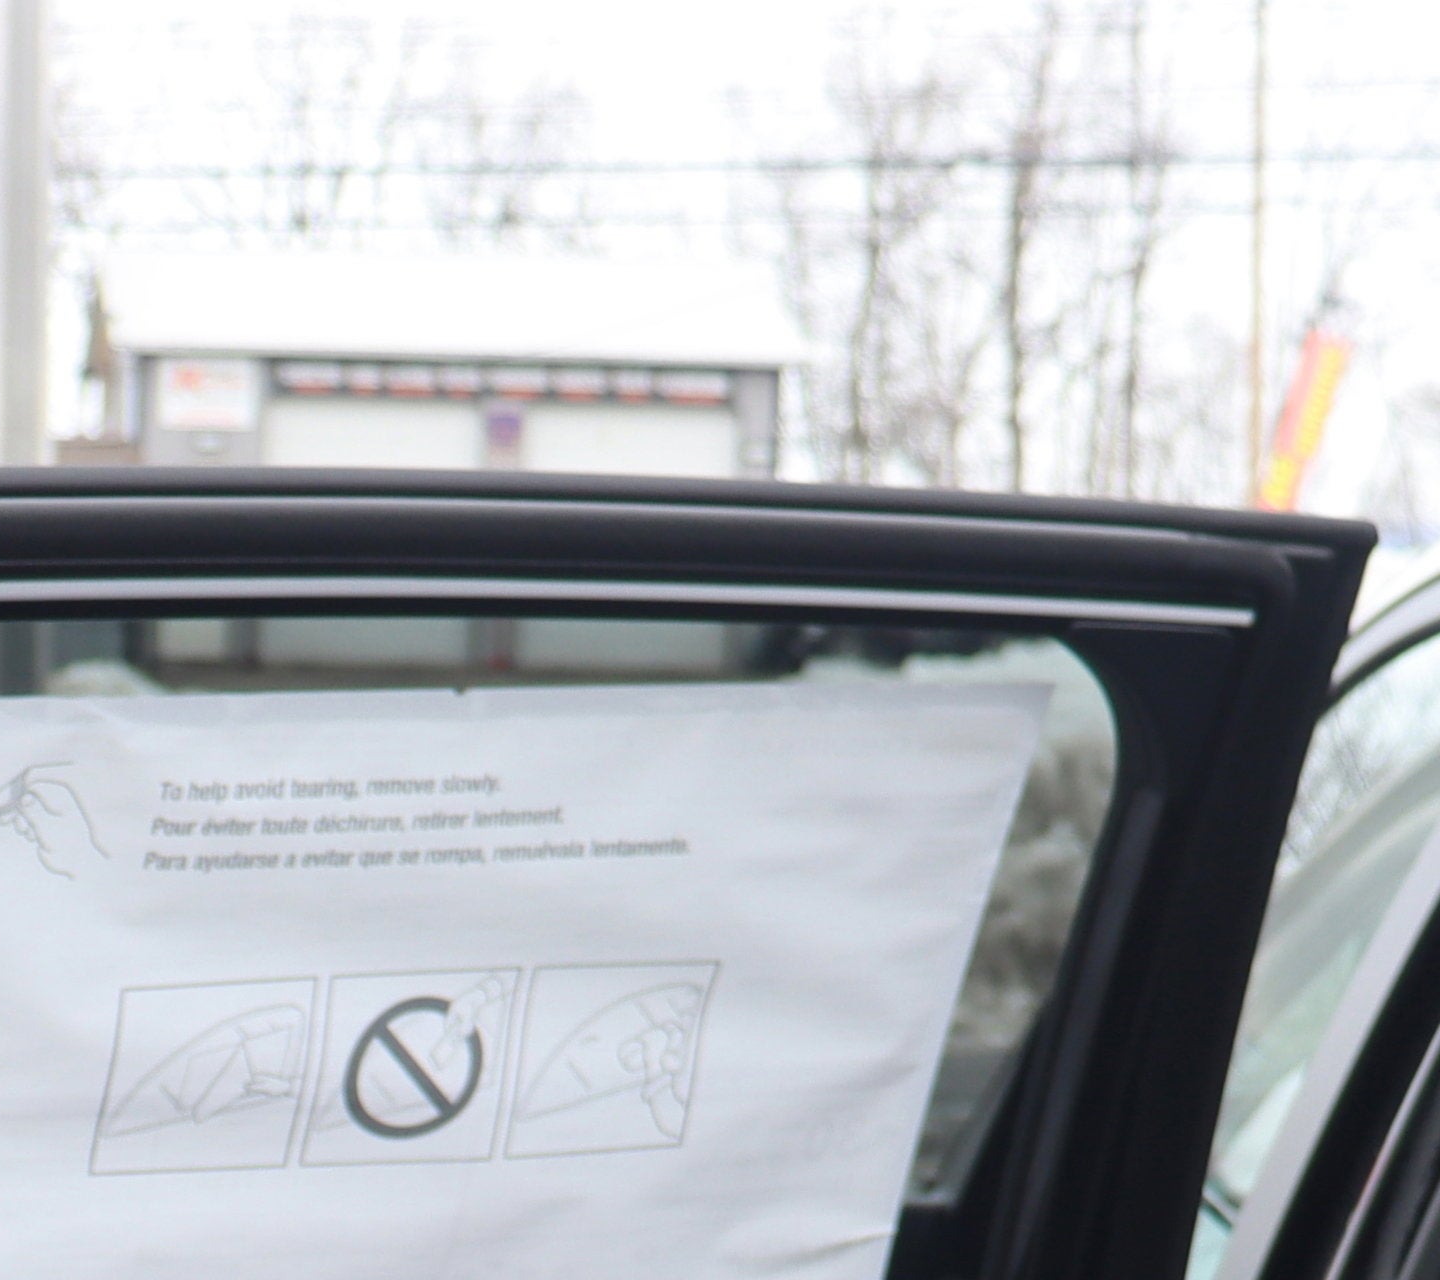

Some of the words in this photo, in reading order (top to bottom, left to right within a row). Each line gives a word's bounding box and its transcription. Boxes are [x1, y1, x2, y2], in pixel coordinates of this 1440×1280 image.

[162, 782, 183, 800] To
[190, 781, 230, 804] help
[235, 780, 285, 799] avoid
[293, 778, 360, 801] tearing,
[367, 778, 434, 795] remove
[441, 774, 500, 795] slowly.
[152, 817, 197, 836] Pour
[203, 817, 258, 836] éviter
[262, 817, 308, 835] toute
[315, 815, 406, 833] déchirure,
[413, 811, 470, 829] retirer
[474, 806, 563, 825] lentement.
[144, 852, 188, 870] Para
[195, 852, 280, 872] ayudarse
[285, 854, 297, 868] a
[302, 850, 355, 868] evitar
[360, 851, 395, 870] que
[399, 850, 422, 865] se
[426, 848, 488, 867] rompa,
[591, 837, 691, 858] lentamente.
